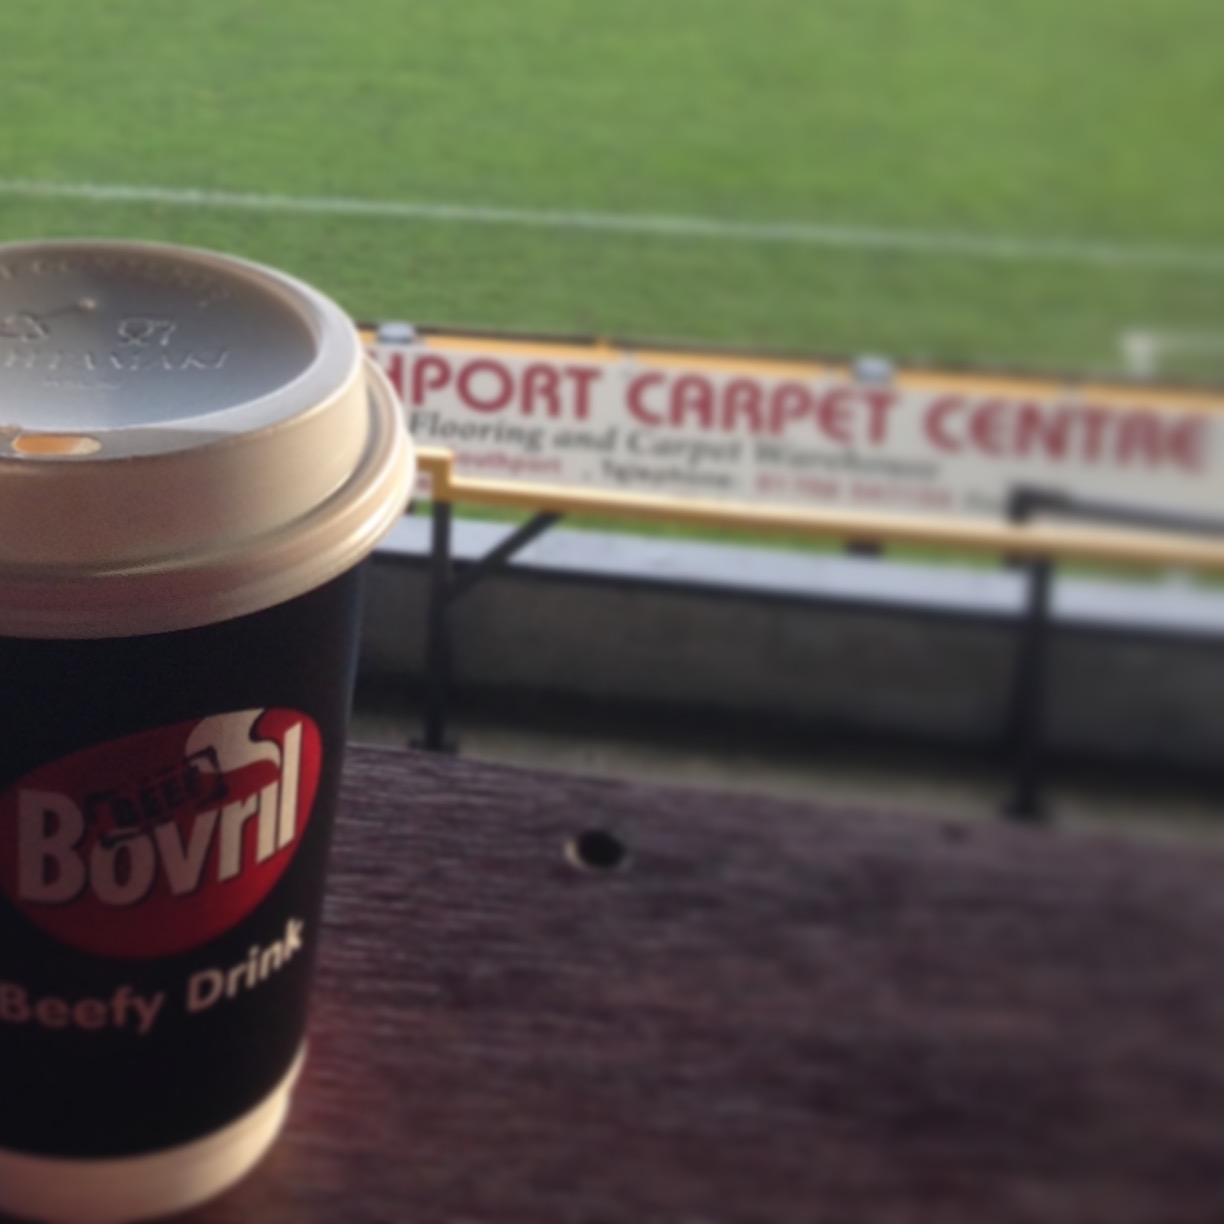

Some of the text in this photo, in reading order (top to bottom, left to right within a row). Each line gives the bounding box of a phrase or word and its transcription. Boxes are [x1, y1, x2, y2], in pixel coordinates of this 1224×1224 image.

[408, 410, 546, 453] Flooring
[552, 426, 617, 452] and
[626, 430, 743, 465] Carpet
[625, 371, 900, 447] CARPET
[922, 392, 1208, 477] CENTRE
[17, 720, 302, 906] Bovril
[186, 917, 304, 1013] Drink
